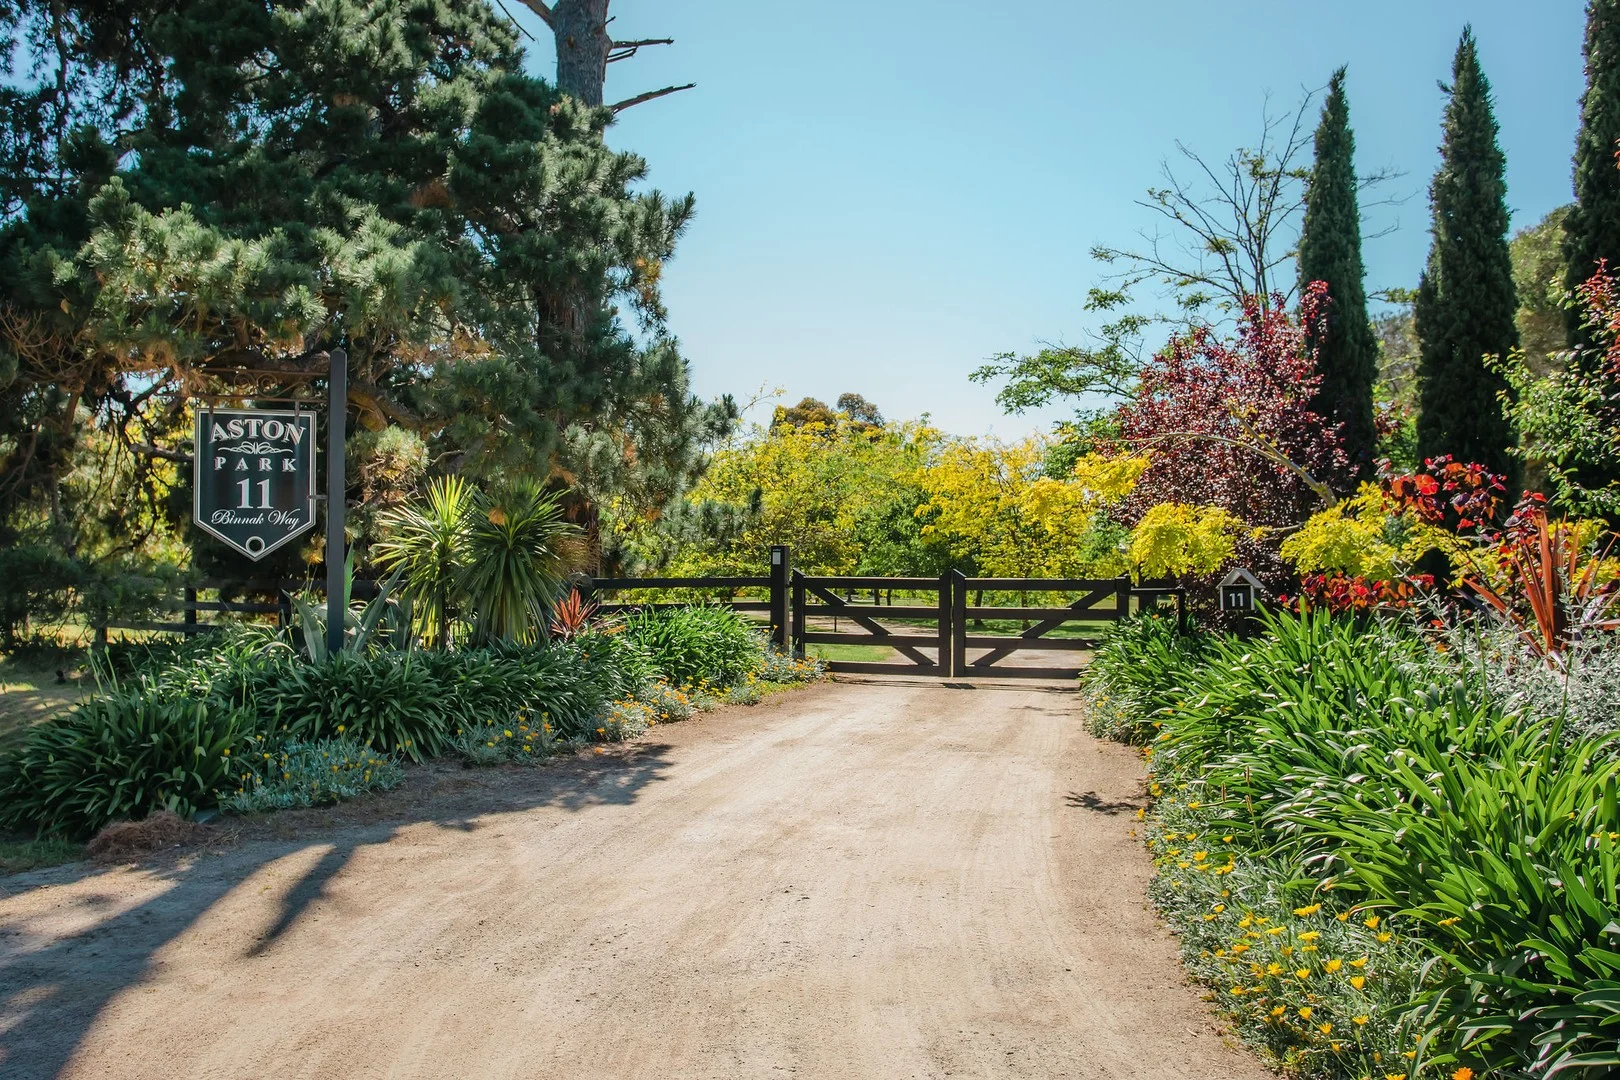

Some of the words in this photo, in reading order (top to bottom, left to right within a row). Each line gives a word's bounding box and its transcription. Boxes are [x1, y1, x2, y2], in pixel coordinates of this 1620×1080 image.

[208, 418, 306, 445] ASTON
[214, 456, 297, 472] PARK
[236, 478, 274, 509] 11
[211, 508, 264, 525] Binnak
[267, 508, 301, 531] Way
[1229, 592, 1244, 607] 11
